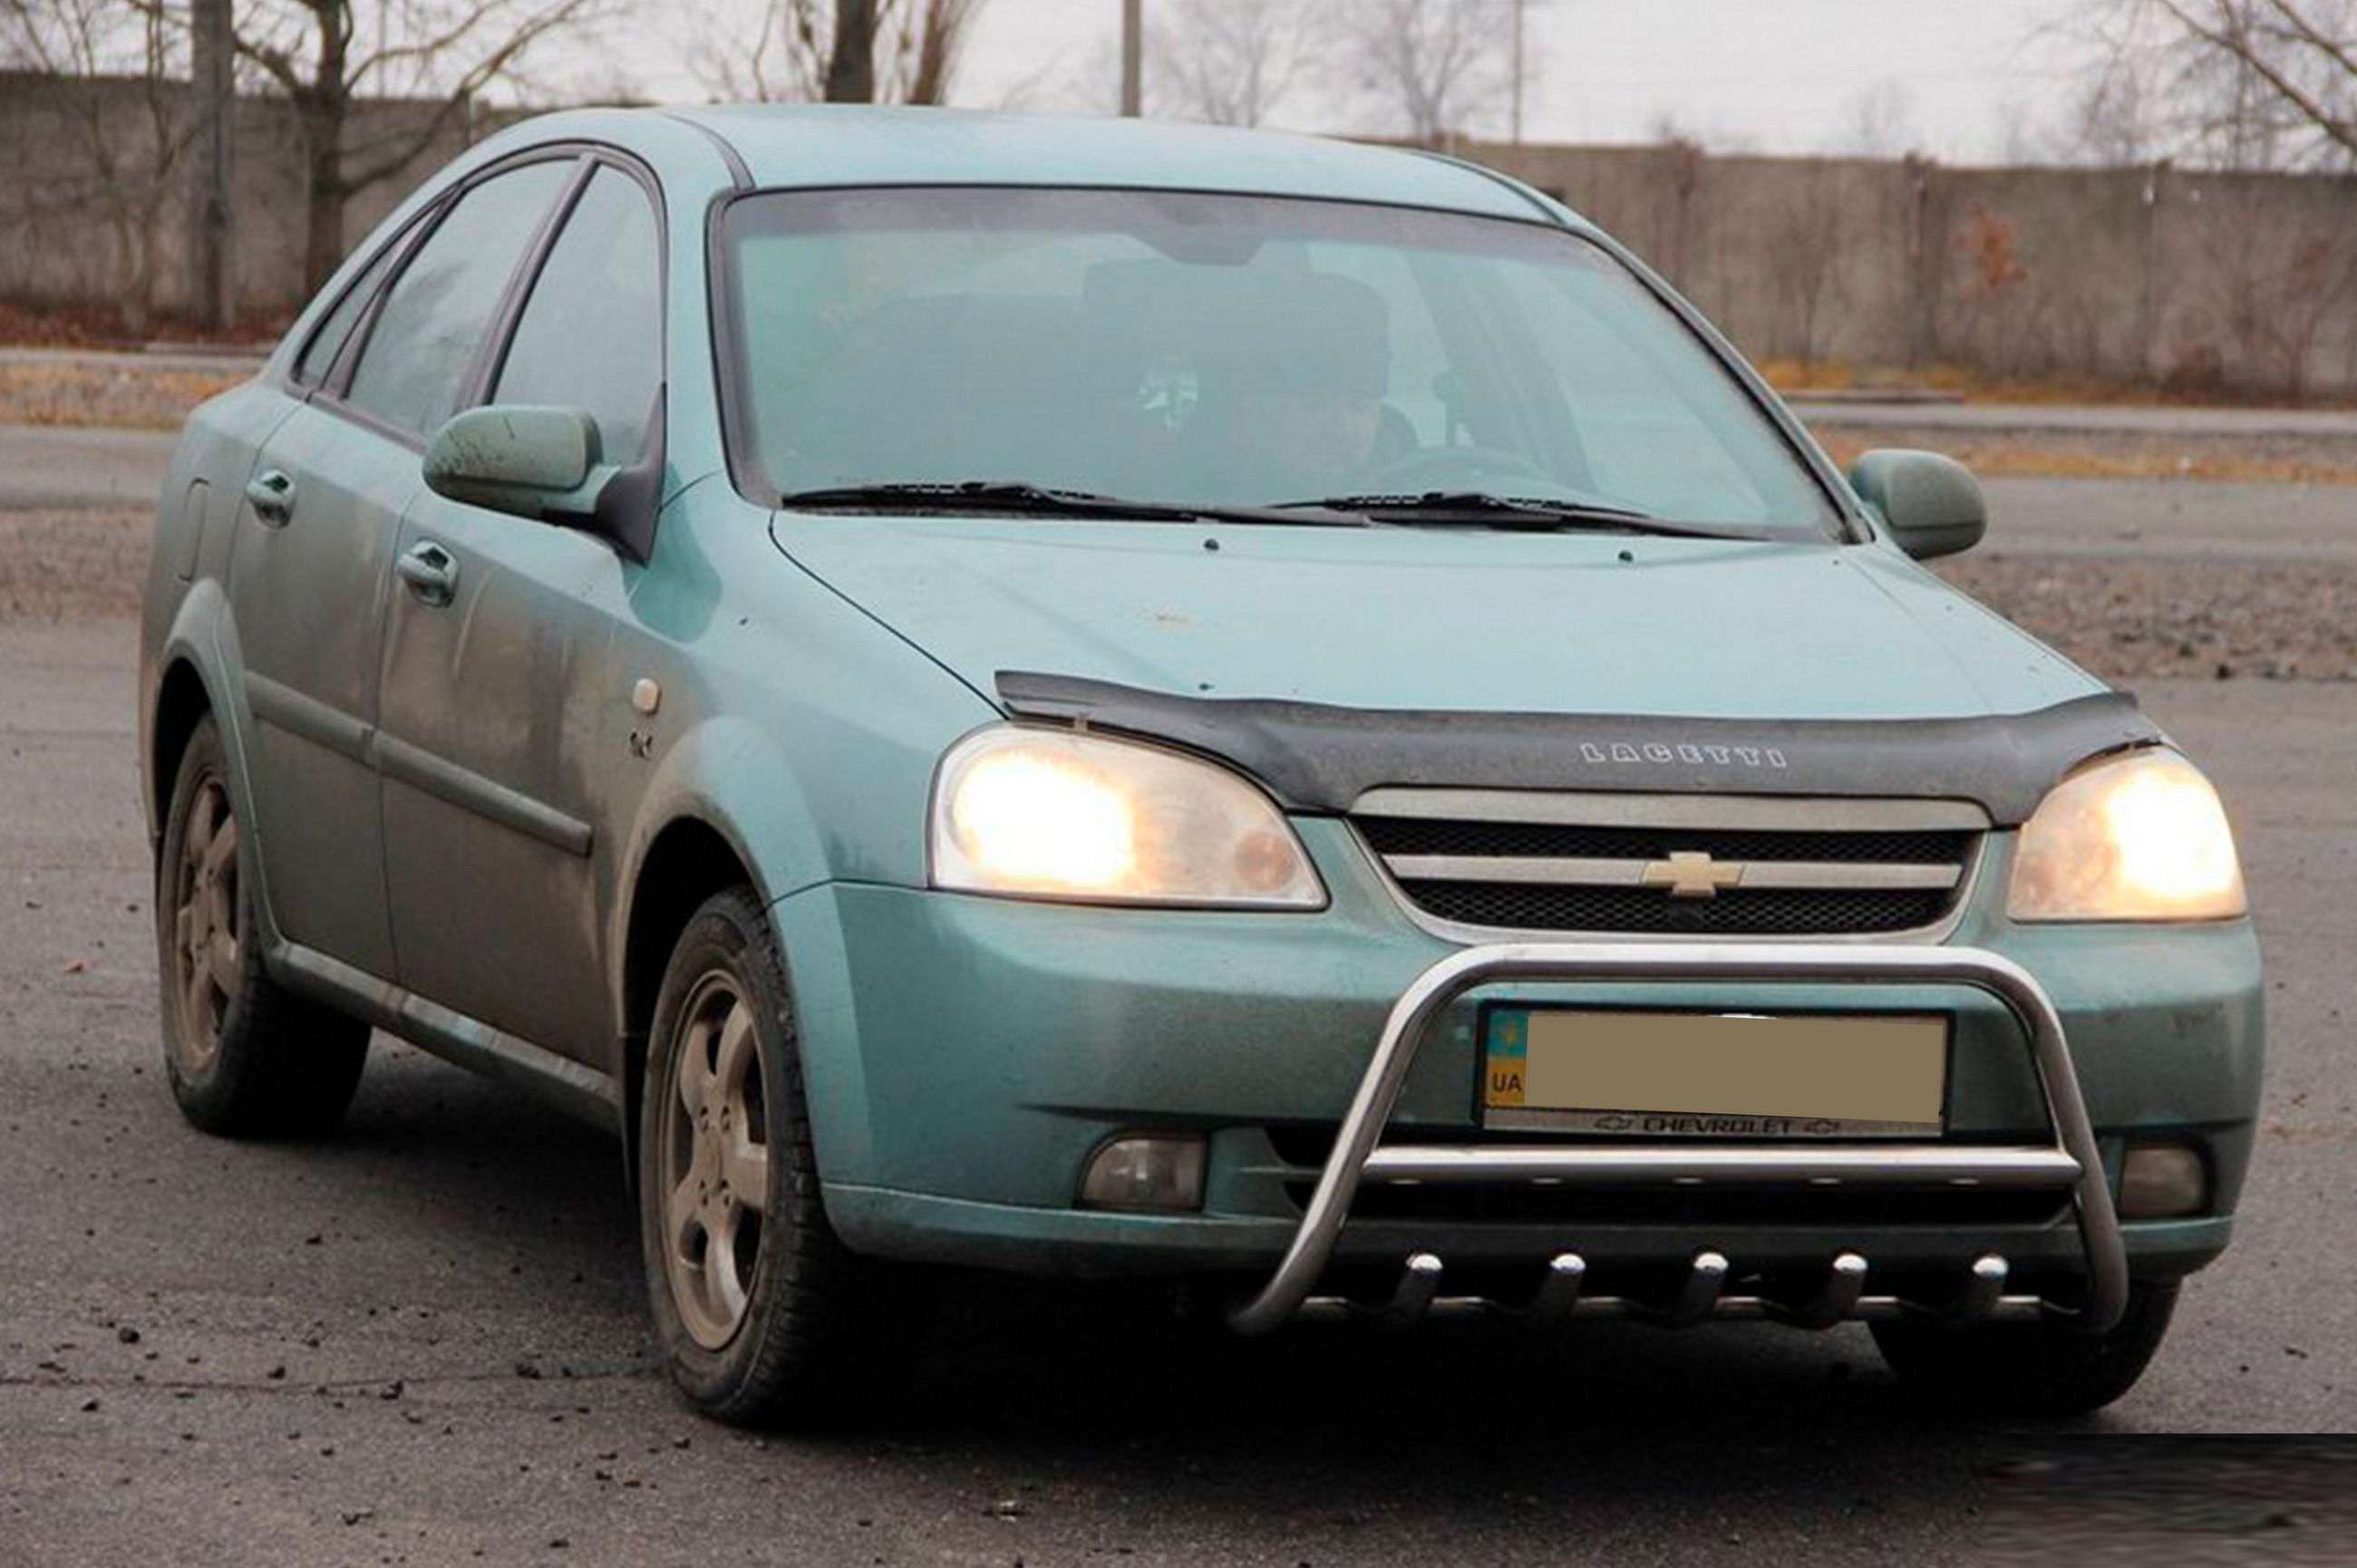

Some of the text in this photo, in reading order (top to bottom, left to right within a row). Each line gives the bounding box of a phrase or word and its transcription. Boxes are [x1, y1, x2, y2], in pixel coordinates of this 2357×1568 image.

[1580, 742, 1788, 768] LACETTI
[1492, 1073, 1523, 1093] UA
[1643, 1116, 1797, 1134] CHEVROLET
